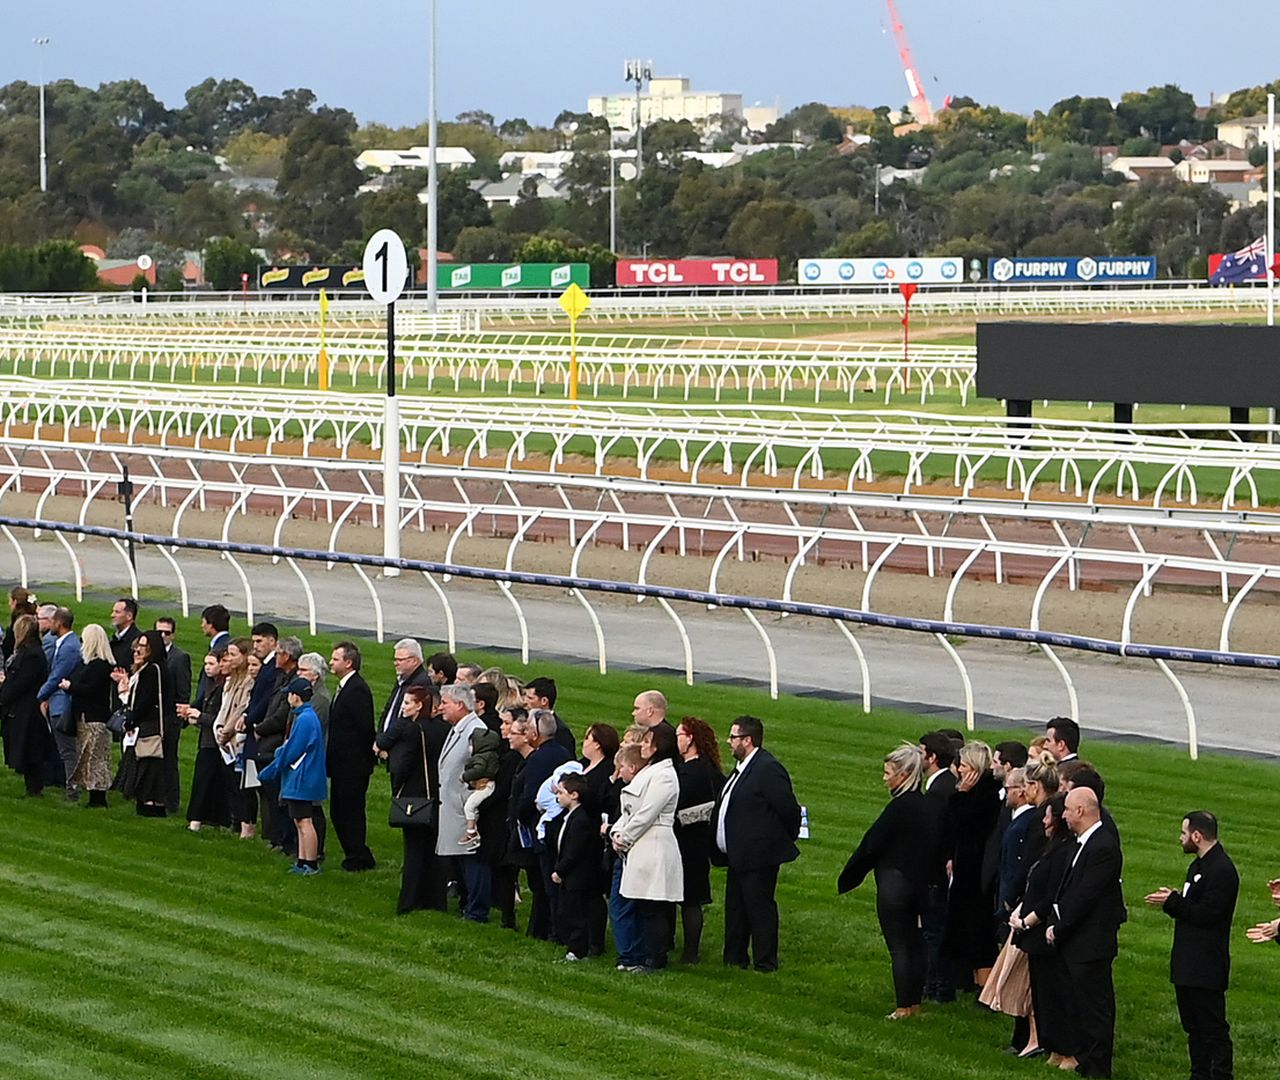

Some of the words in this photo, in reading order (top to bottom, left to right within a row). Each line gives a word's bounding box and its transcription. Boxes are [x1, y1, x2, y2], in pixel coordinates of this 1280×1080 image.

[375, 241, 388, 292] 1
[630, 263, 683, 283] TCL
[711, 263, 765, 282] TCL
[1015, 262, 1067, 277] FURPHY
[1098, 261, 1150, 276] FURPHY
